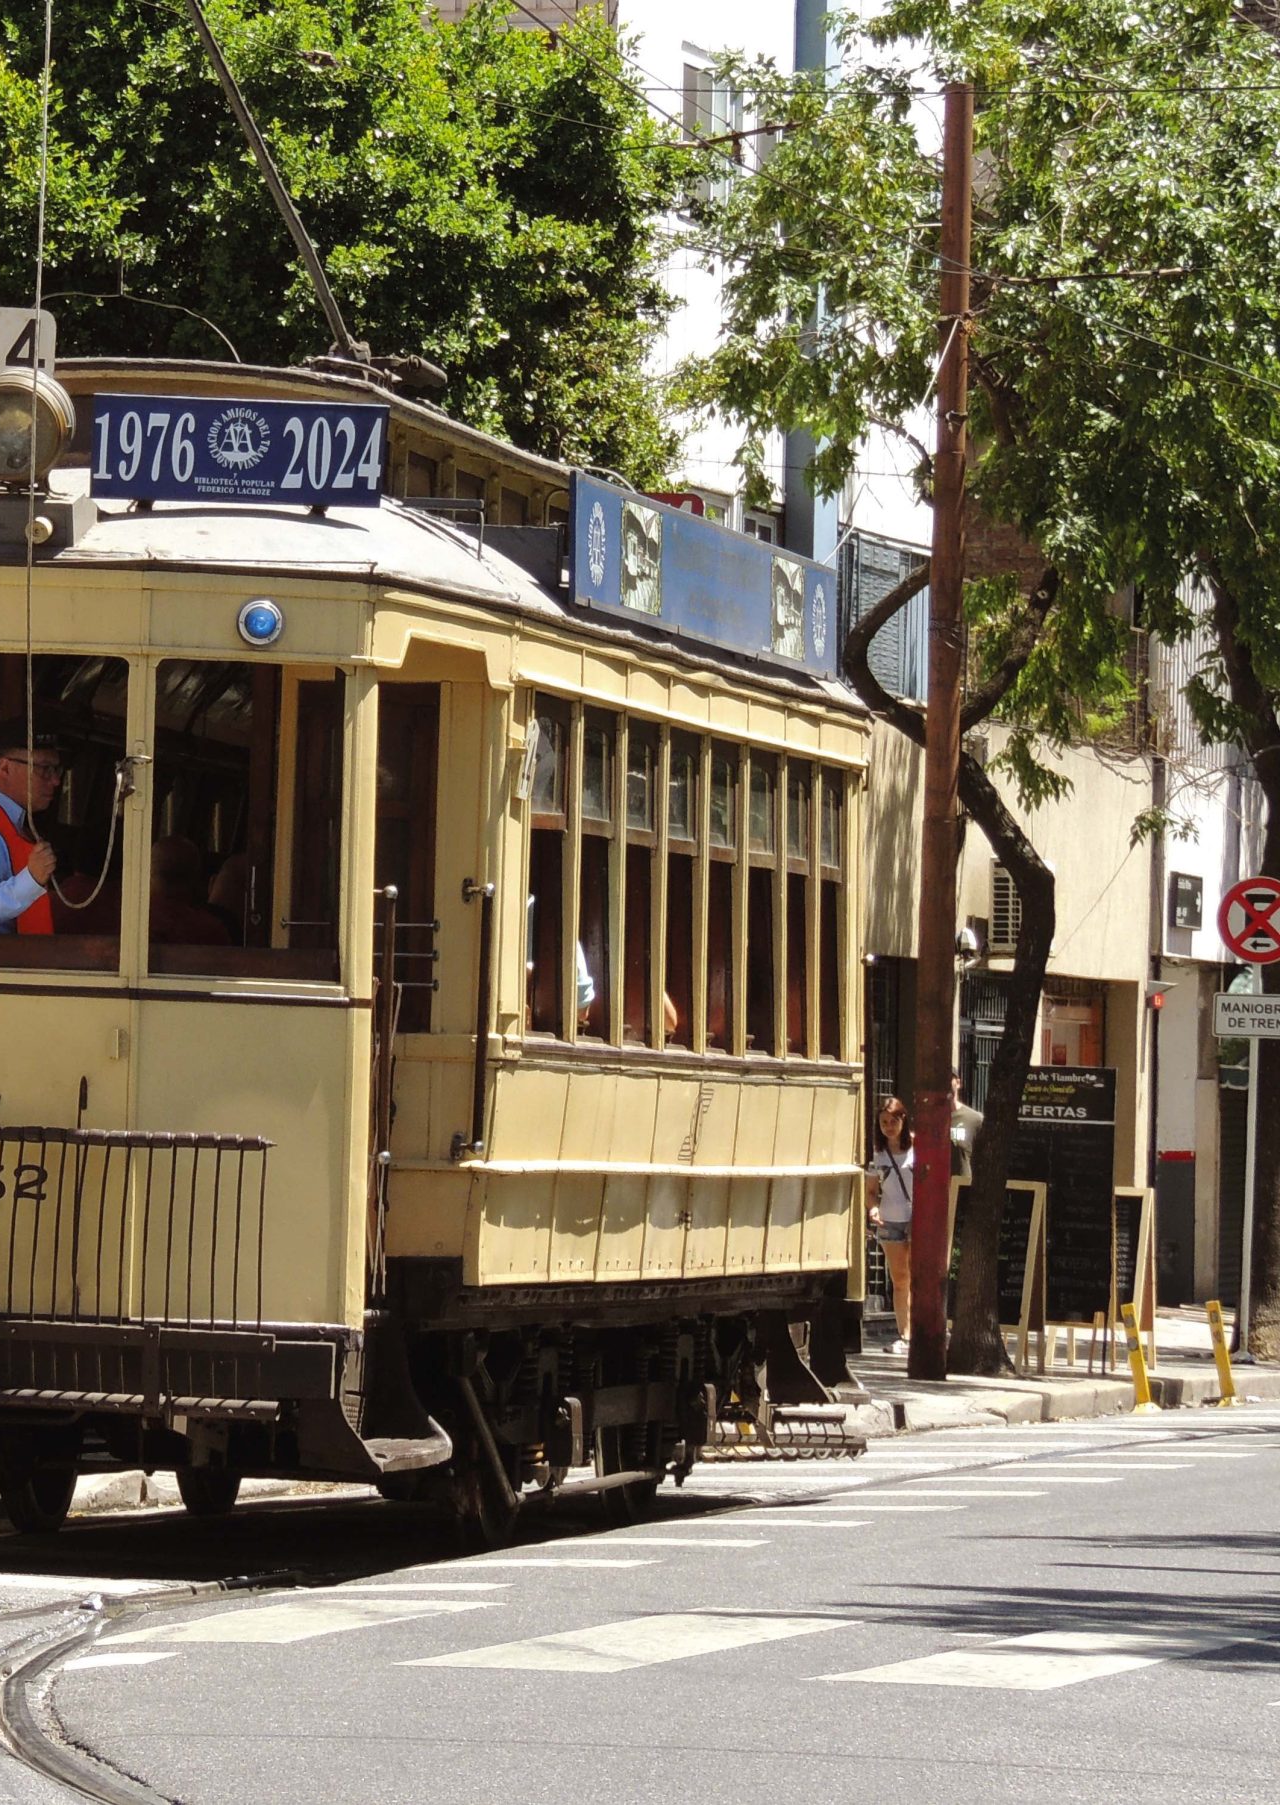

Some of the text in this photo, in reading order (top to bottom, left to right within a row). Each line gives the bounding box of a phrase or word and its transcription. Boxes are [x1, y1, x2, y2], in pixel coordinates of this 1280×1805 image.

[221, 407, 259, 423] AMIGOS
[256, 417, 270, 438] DEL
[93, 411, 196, 482] 1976
[207, 419, 236, 470] ASOCIACION
[280, 416, 382, 490] 2024
[194, 477, 275, 488] BIBLIOTECA POPULAR
[197, 485, 271, 496] FEDERICO LACROZE
[1228, 1017, 1246, 1028] DE
[1019, 1104, 1087, 1118] FERTAS
